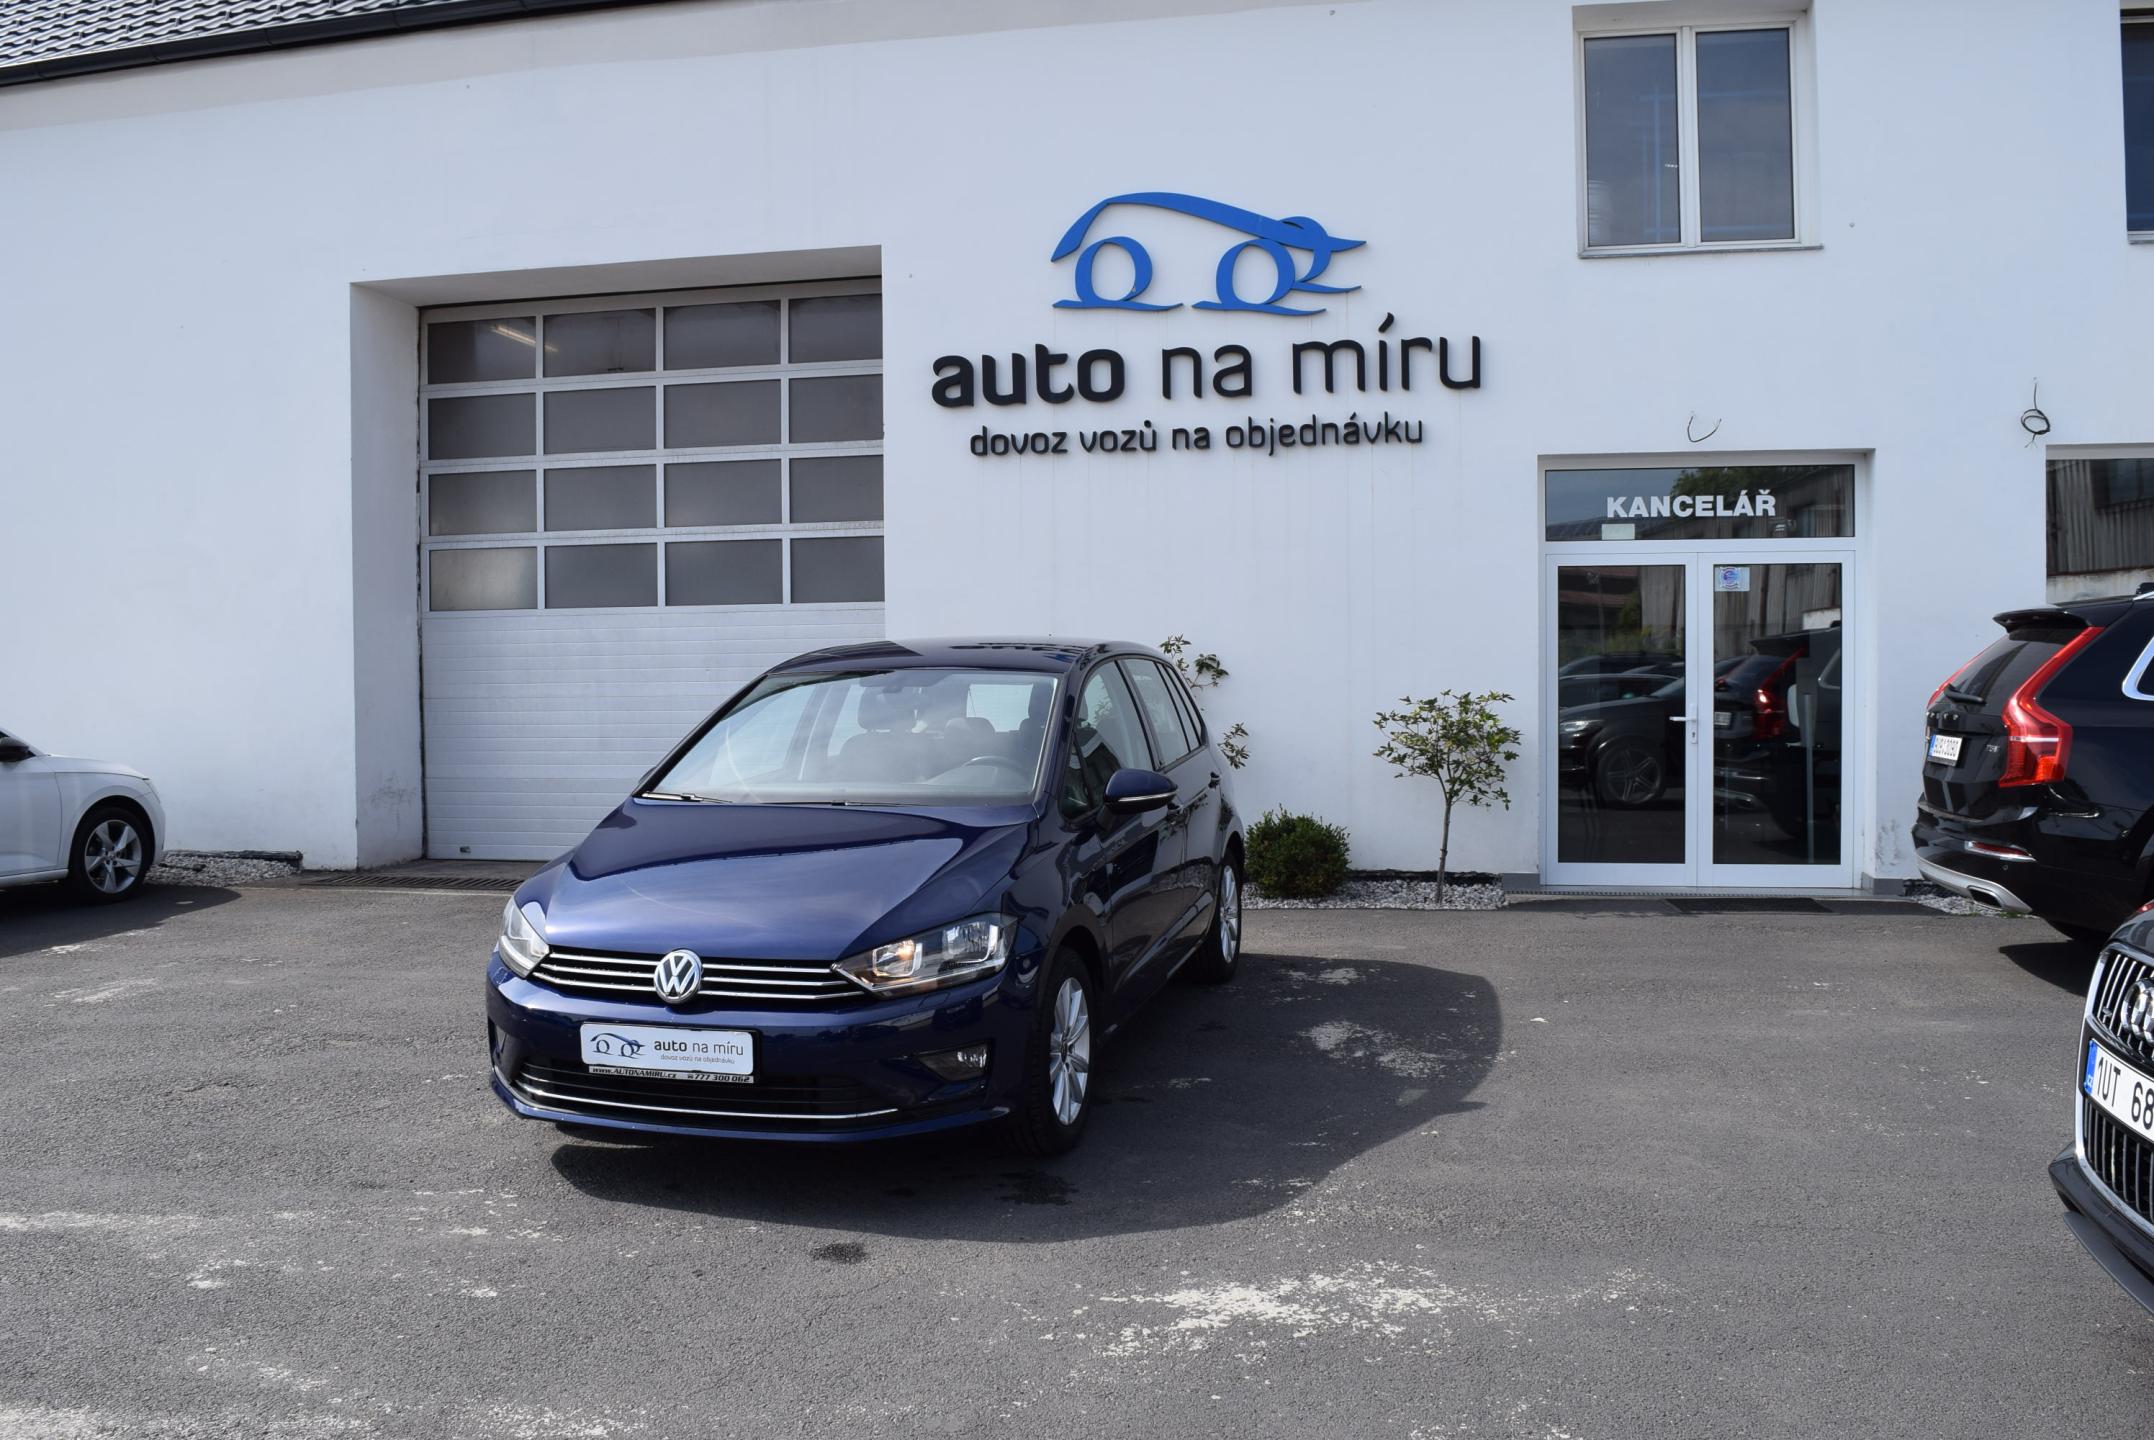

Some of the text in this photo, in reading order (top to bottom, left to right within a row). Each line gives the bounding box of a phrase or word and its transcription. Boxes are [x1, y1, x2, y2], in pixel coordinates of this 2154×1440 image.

[931, 312, 1482, 408] auto na míru
[969, 411, 1423, 457] dovoz vozů na objednávku
[1607, 489, 1776, 518] KANCELÁŘ
[654, 1040, 743, 1055] auto na míru
[694, 1073, 711, 1081] 777
[731, 1075, 750, 1083] 062
[2097, 1056, 2154, 1131] 1UT 68
